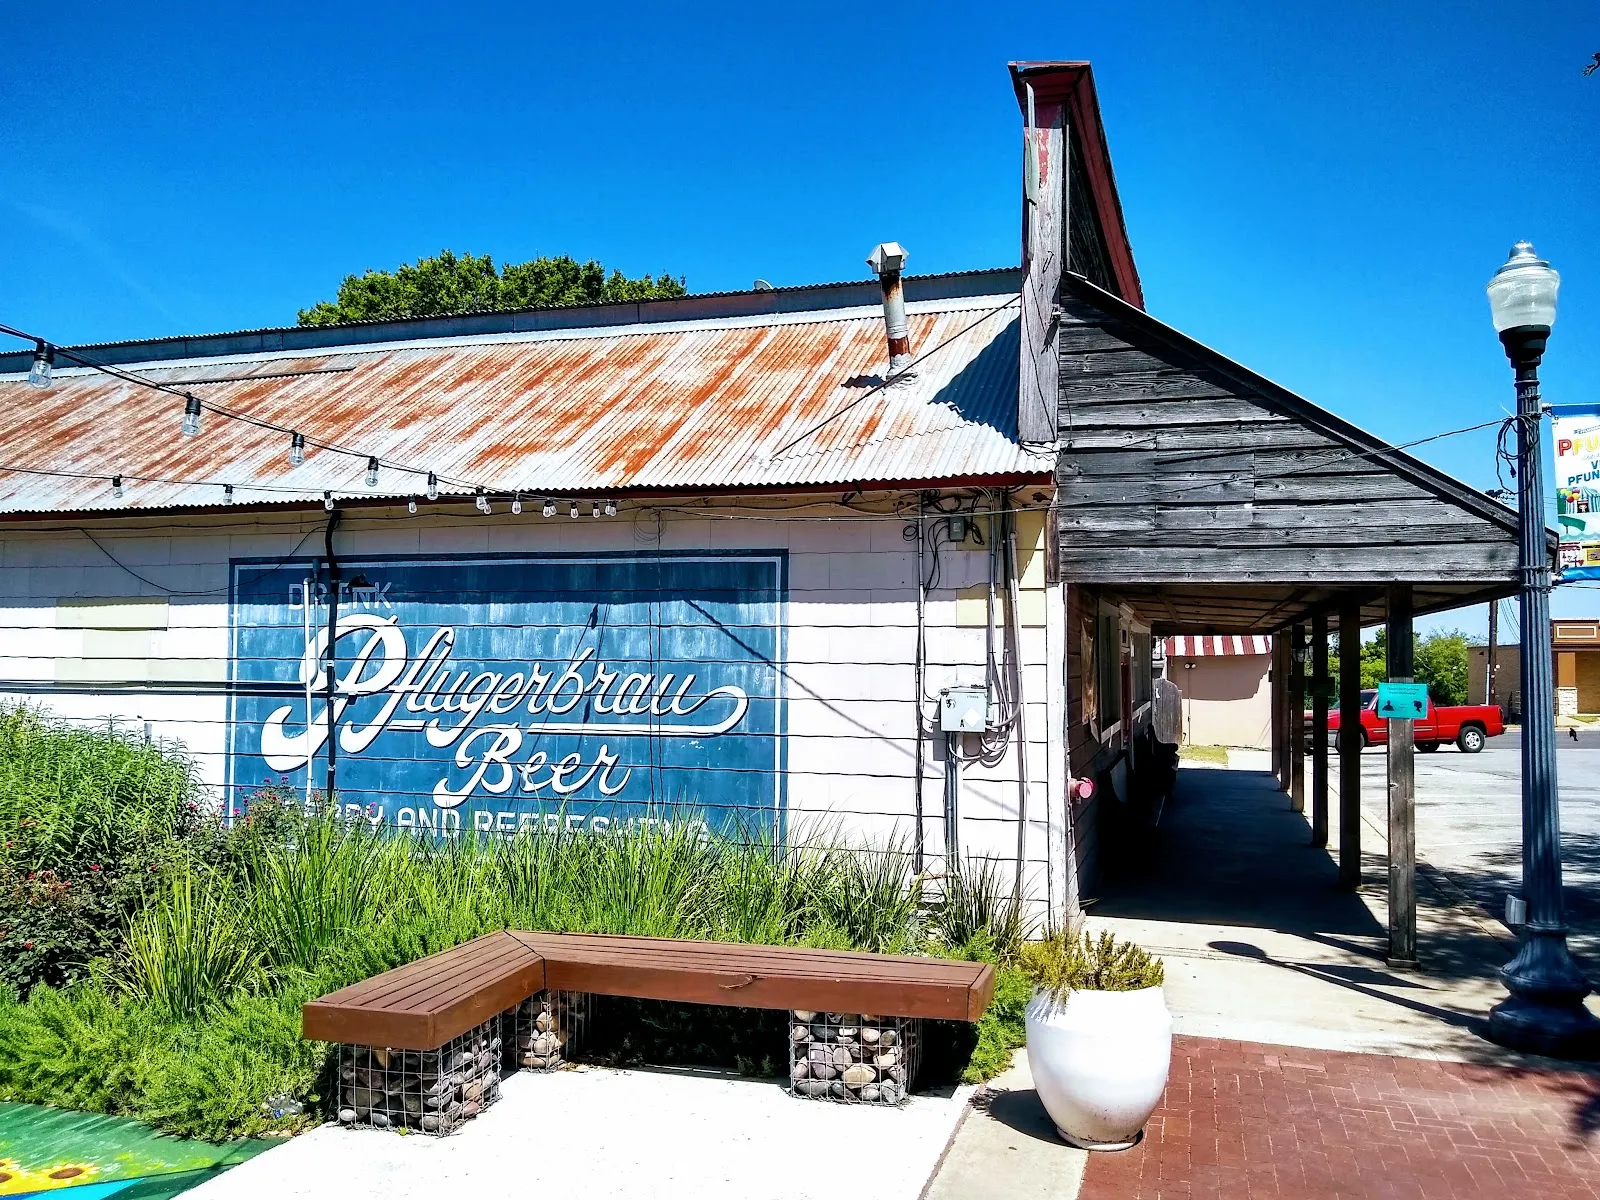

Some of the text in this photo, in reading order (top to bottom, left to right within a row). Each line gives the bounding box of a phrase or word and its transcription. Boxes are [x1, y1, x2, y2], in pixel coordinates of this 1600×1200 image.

[261, 614, 749, 772] Pflugerbrau
[433, 722, 632, 808] Beer
[397, 806, 460, 839] AND
